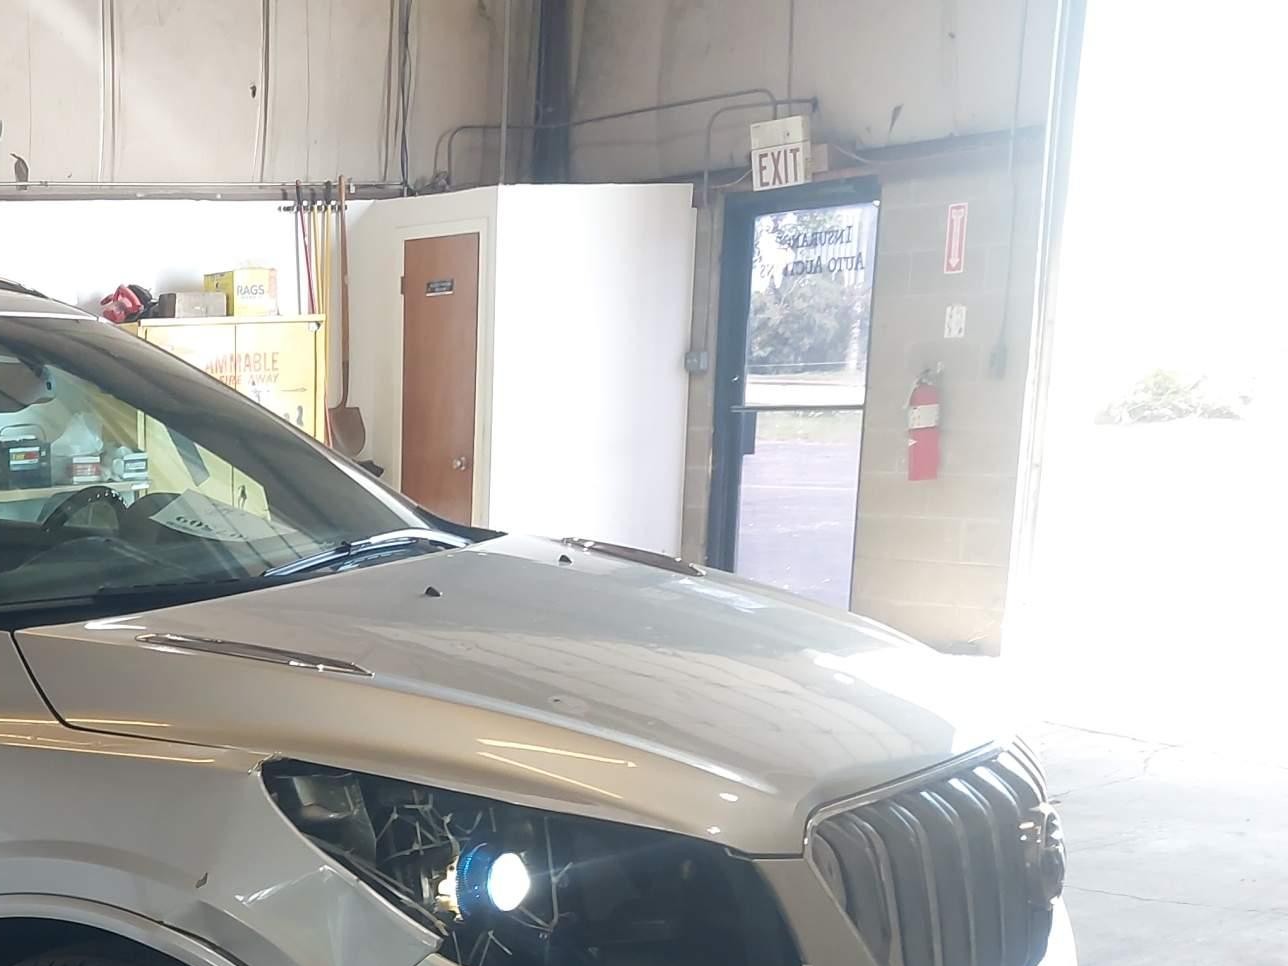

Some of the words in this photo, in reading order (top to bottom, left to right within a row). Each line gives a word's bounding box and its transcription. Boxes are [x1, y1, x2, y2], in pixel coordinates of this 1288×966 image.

[759, 148, 800, 187] EXIT
[237, 285, 264, 296] RAGS
[205, 352, 279, 374] AMMABLE
